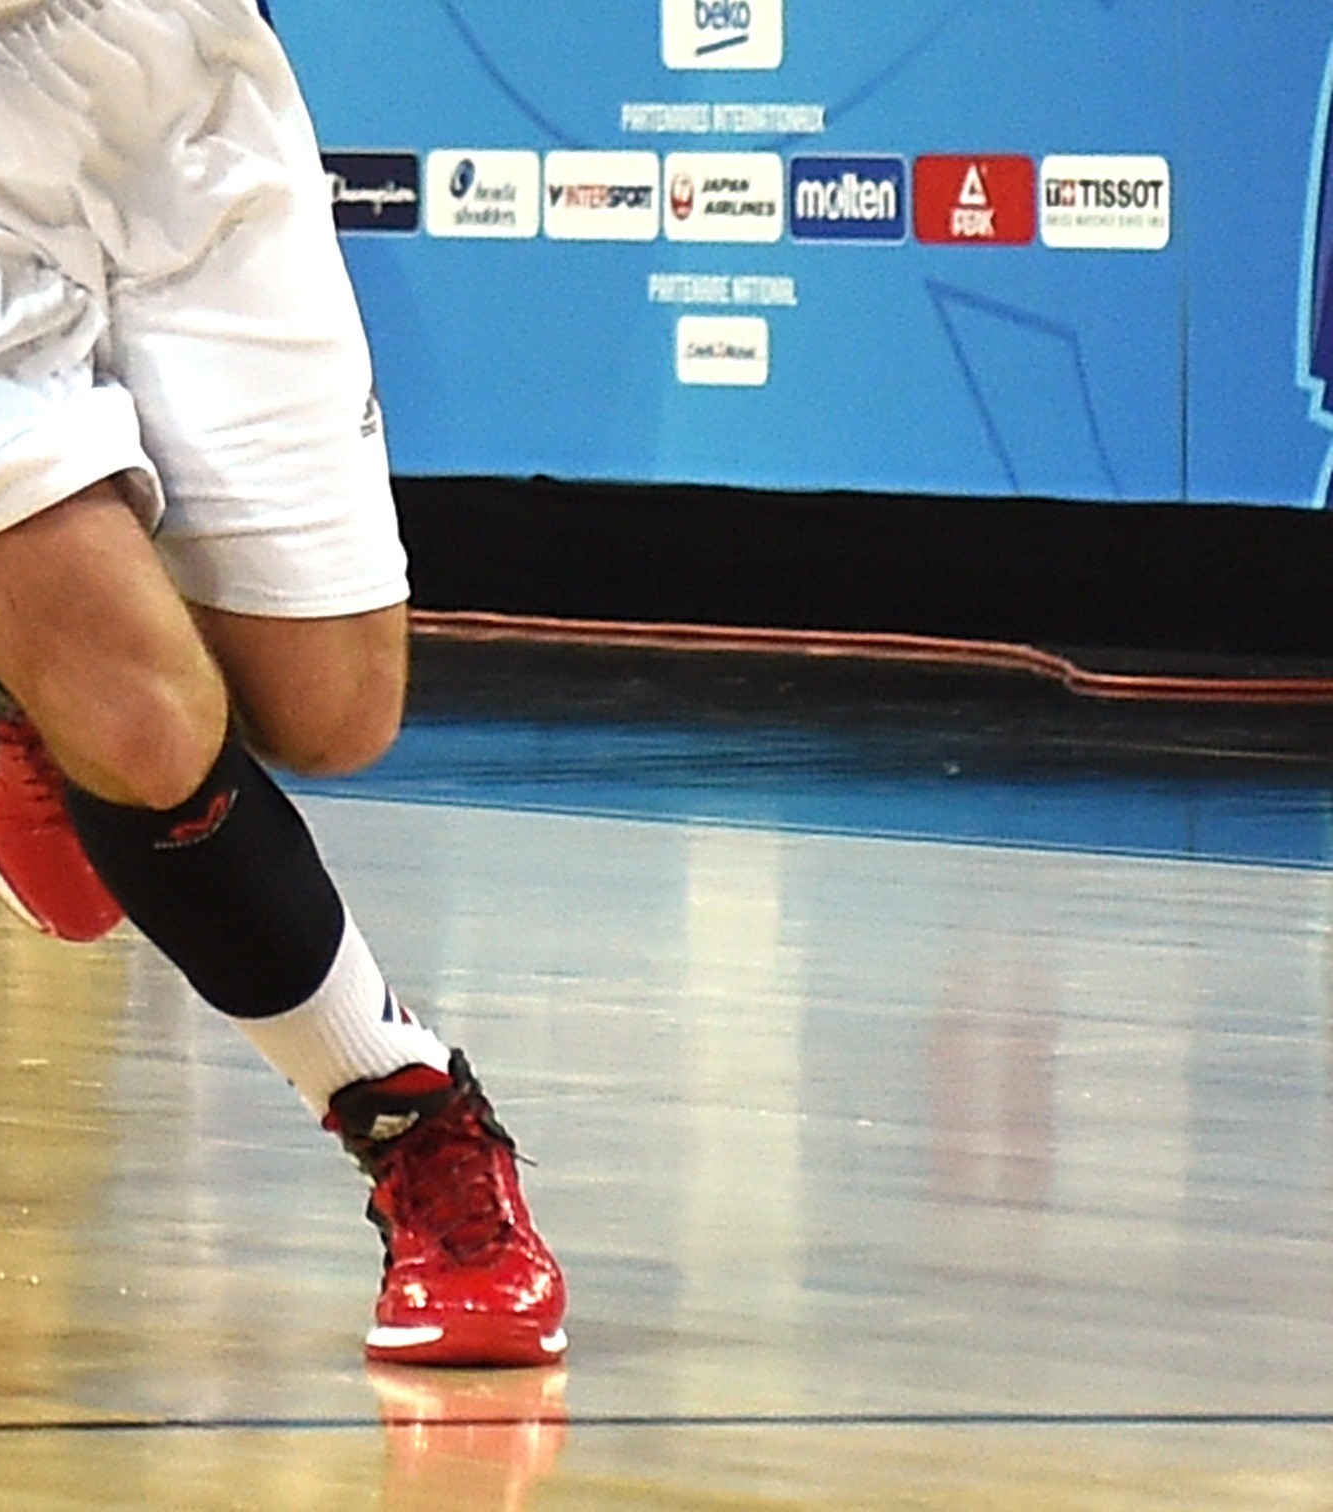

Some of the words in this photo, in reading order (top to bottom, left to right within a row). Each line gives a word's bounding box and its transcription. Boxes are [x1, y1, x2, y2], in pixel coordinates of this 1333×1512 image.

[565, 185, 653, 209] INTERSPORT
[702, 177, 749, 194] JAPAN
[796, 172, 897, 222] molten
[1078, 178, 1164, 209] TISSOT
[703, 200, 776, 218] AIRLINES
